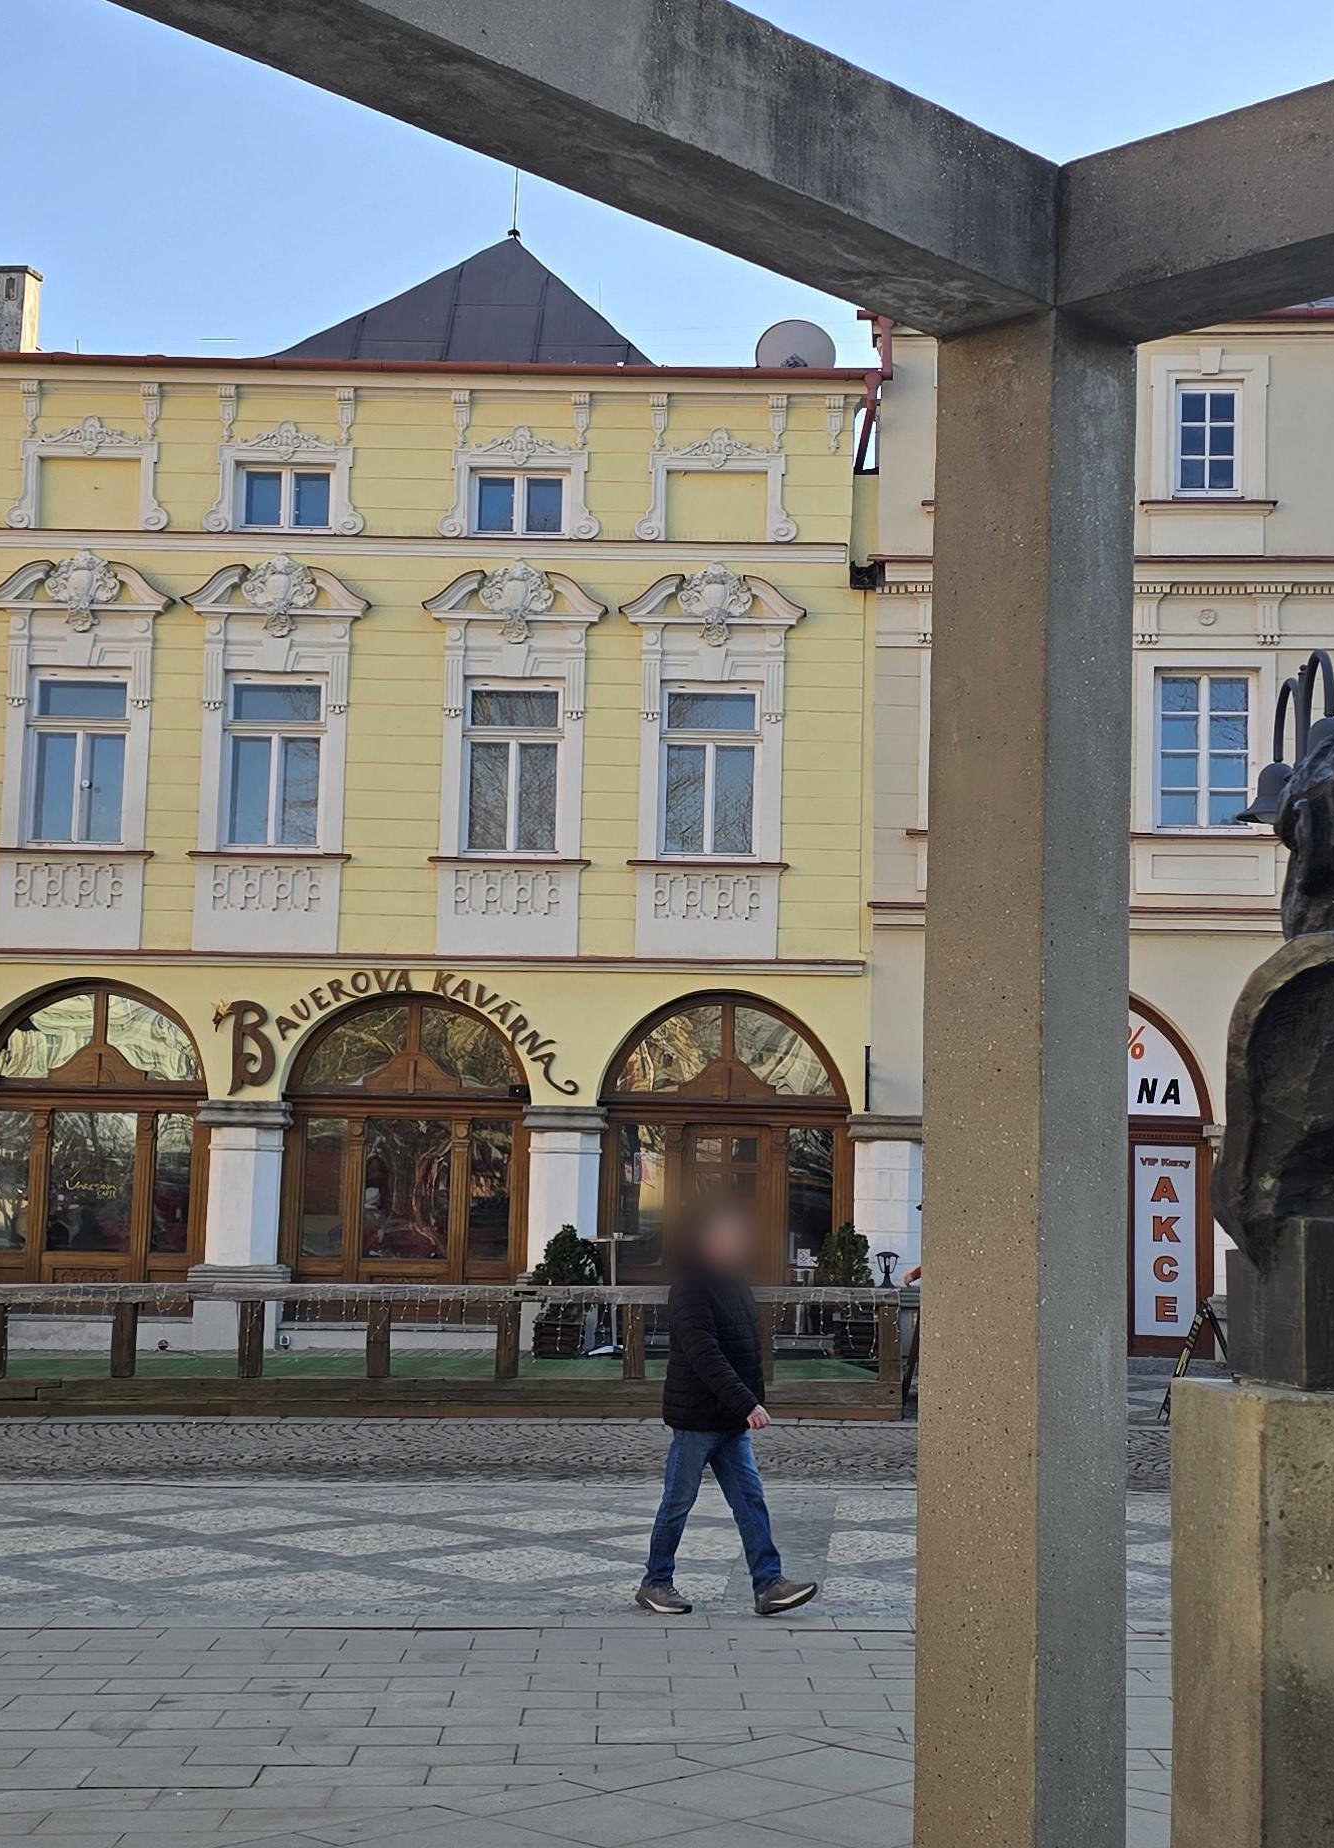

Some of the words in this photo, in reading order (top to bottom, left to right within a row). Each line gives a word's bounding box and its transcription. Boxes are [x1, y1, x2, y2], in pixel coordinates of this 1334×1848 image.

[227, 968, 413, 1096] BAUEROVA
[432, 970, 579, 1095] KAVÁRNA
[1151, 1176, 1181, 1323] AKCE
